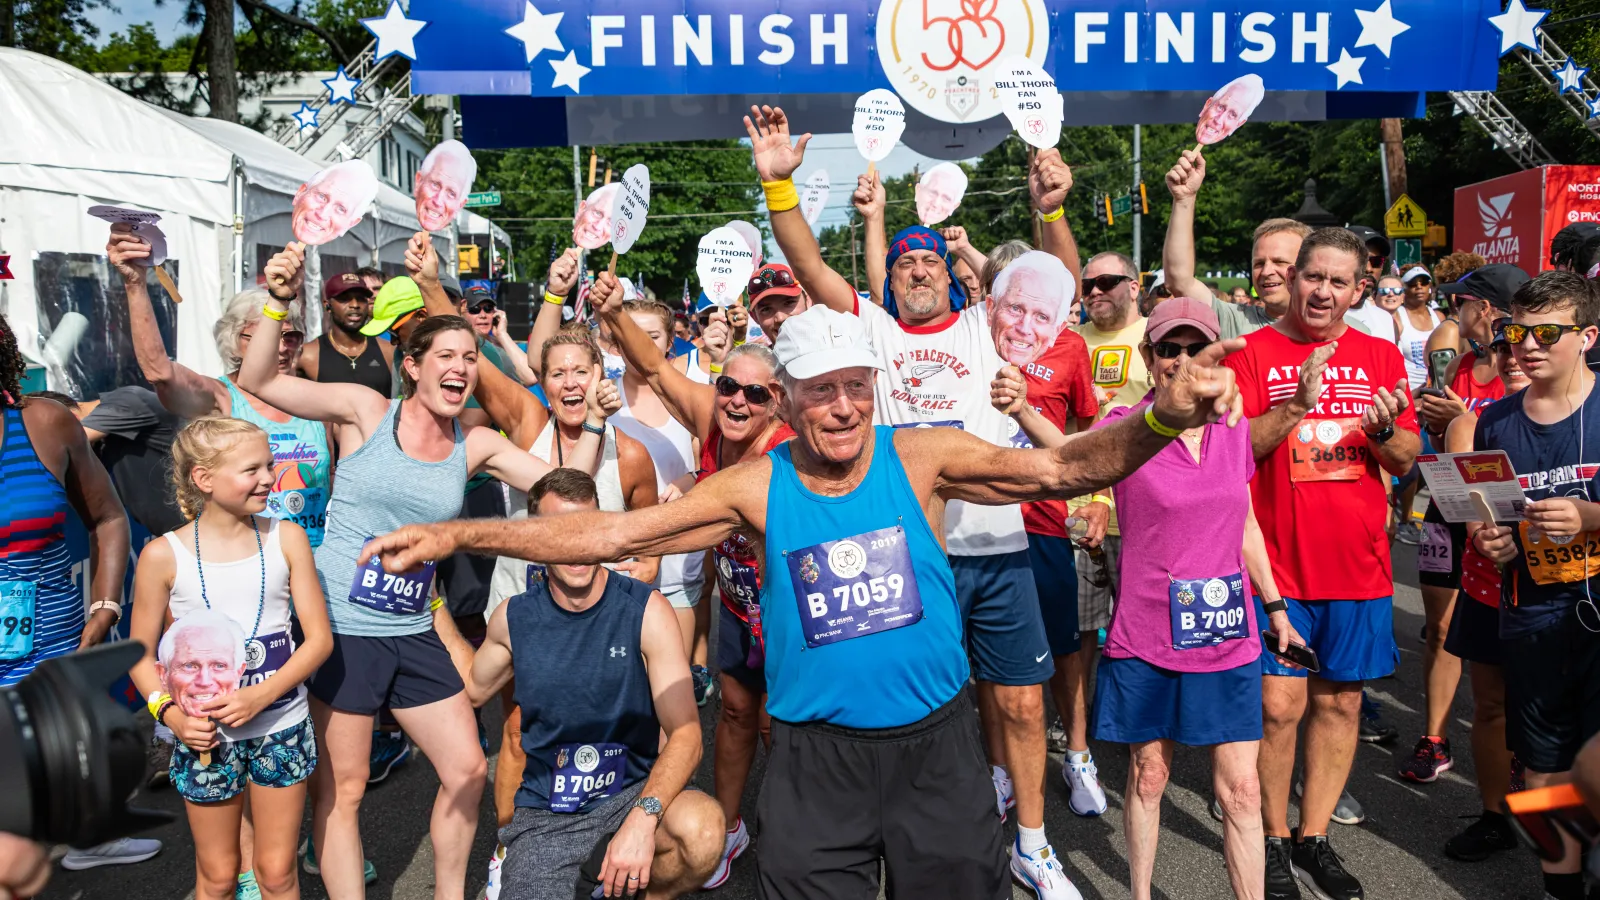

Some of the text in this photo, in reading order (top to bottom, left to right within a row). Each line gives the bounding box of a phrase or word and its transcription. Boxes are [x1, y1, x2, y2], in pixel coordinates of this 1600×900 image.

[590, 14, 848, 66] FINISH
[1074, 12, 1329, 63] FINISH
[903, 65, 937, 100] 1970
[1020, 80, 1056, 88] THORN
[876, 108, 905, 116] THORN
[1018, 102, 1042, 110] #50
[620, 178, 649, 211] BILL THORN
[1568, 184, 1600, 192] NORT
[625, 196, 636, 208] FAN
[620, 204, 633, 220] #50
[720, 250, 752, 258] THORN
[1472, 236, 1520, 258] ATLANTA
[710, 266, 732, 274] #50
[909, 349, 970, 378] PEACHTREE
[1019, 362, 1054, 381] REE
[1267, 366, 1368, 382] ATNTA
[890, 389, 918, 404] ROAD
[920, 400, 957, 410] RACE
[268, 443, 318, 460] Peachtree
[1292, 446, 1366, 464] L 36839
[1527, 465, 1578, 488] TOP GRIN
[871, 536, 897, 550] 2019
[1527, 538, 1600, 566] S 5382
[362, 569, 424, 599] B 7061
[1231, 580, 1242, 588] 2019
[807, 574, 904, 618] B 7059
[0, 616, 32, 636] 98
[1180, 606, 1244, 630] B 7009
[270, 638, 286, 648] 2019
[604, 748, 622, 756] 2019
[554, 771, 616, 794] B 7060
